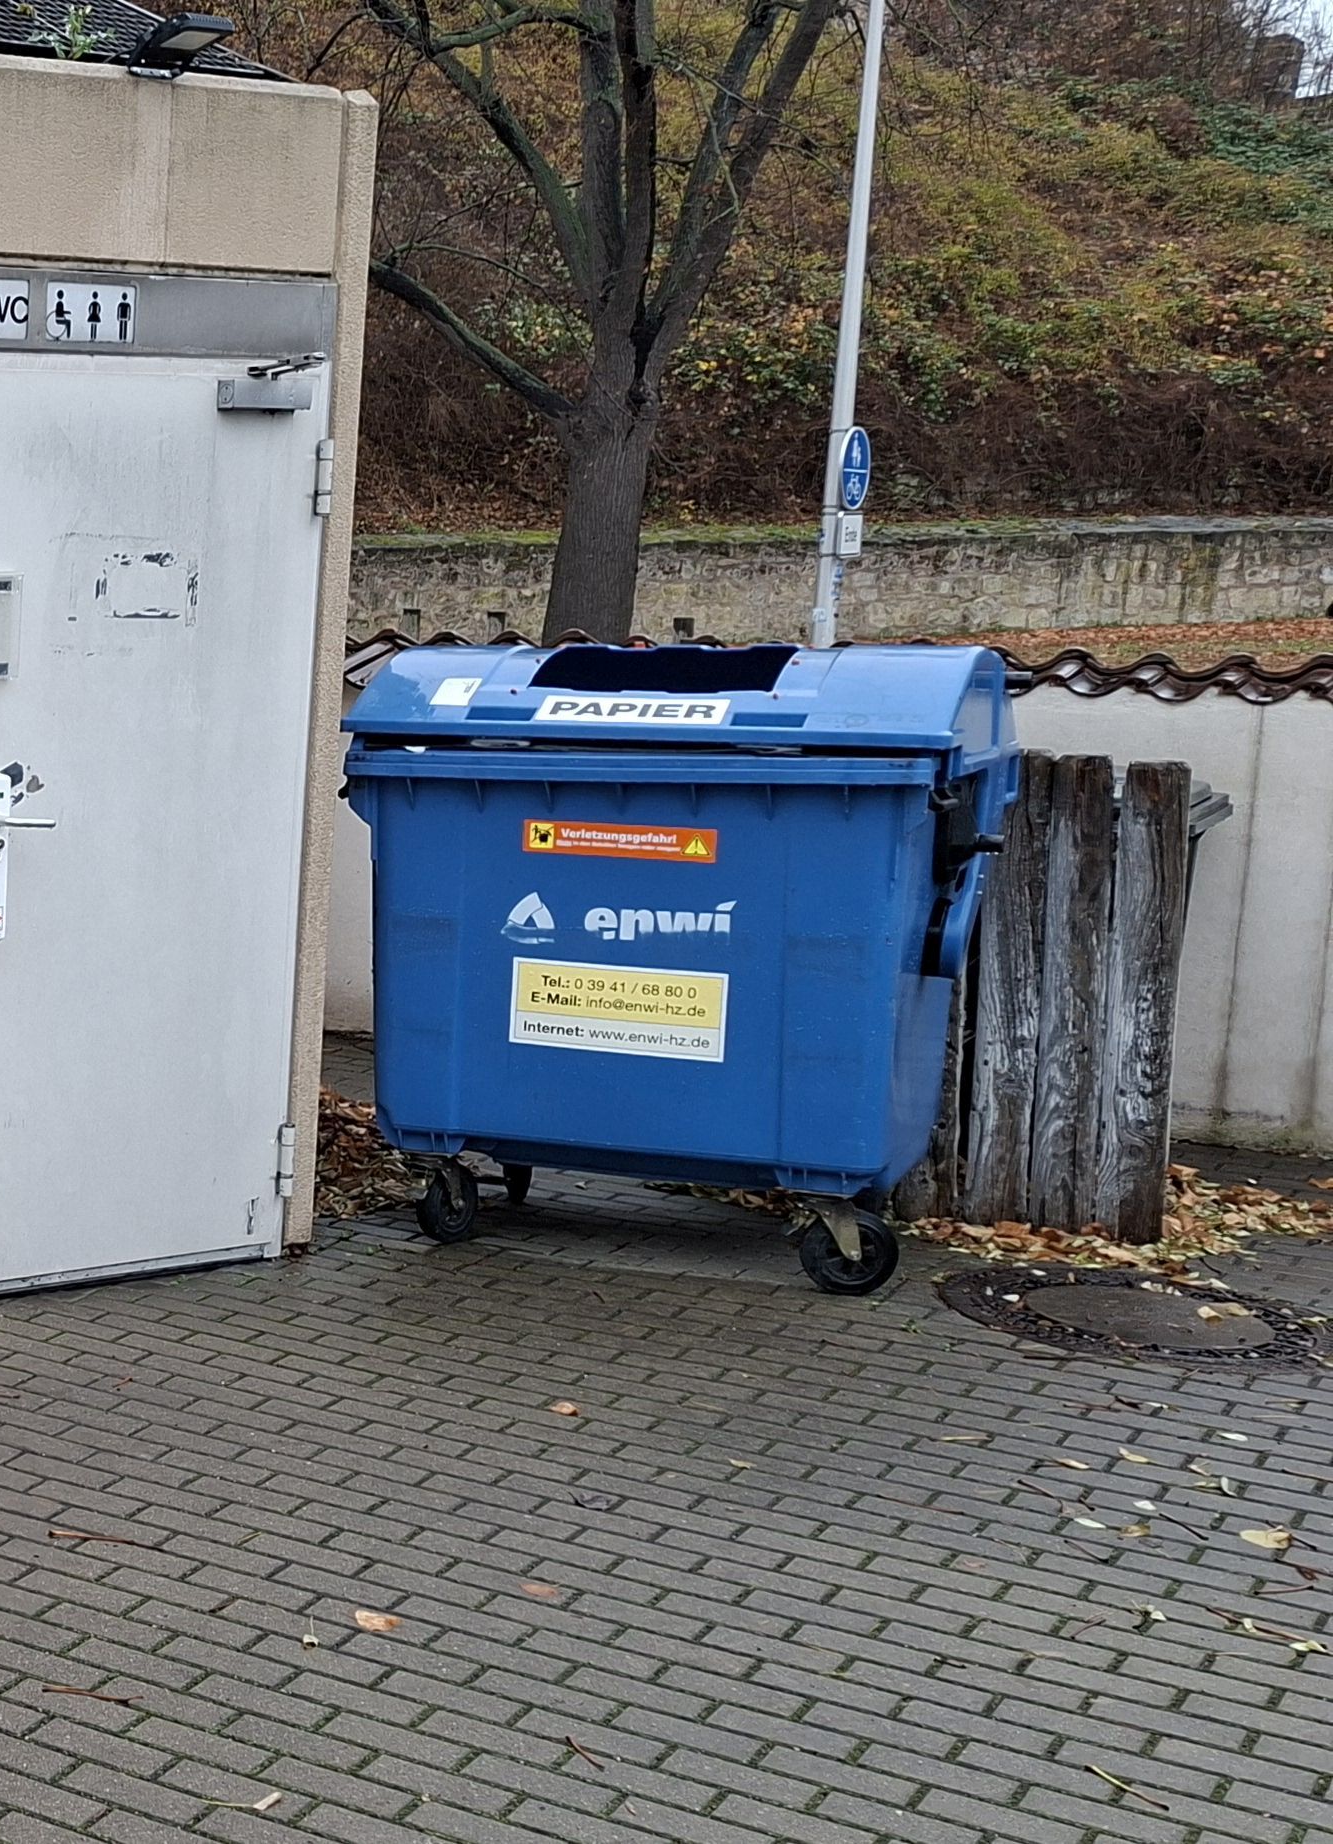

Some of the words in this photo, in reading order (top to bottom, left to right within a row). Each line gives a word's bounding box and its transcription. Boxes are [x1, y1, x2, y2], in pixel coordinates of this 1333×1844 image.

[548, 701, 718, 719] PAPIER
[561, 828, 677, 844] Verletzungsgefahr!
[541, 975, 570, 989] Tel.:
[574, 978, 583, 989] 0
[587, 979, 605, 991] 39
[609, 982, 626, 993] 41
[641, 984, 659, 996] 68
[664, 985, 683, 998] 80
[687, 987, 697, 999] 0
[530, 991, 581, 1007] E-Mail:
[585, 996, 706, 1018] info@enwi-hz.de
[523, 1020, 584, 1037] Internet:
[589, 1027, 710, 1049] www.enwi-hz.de
